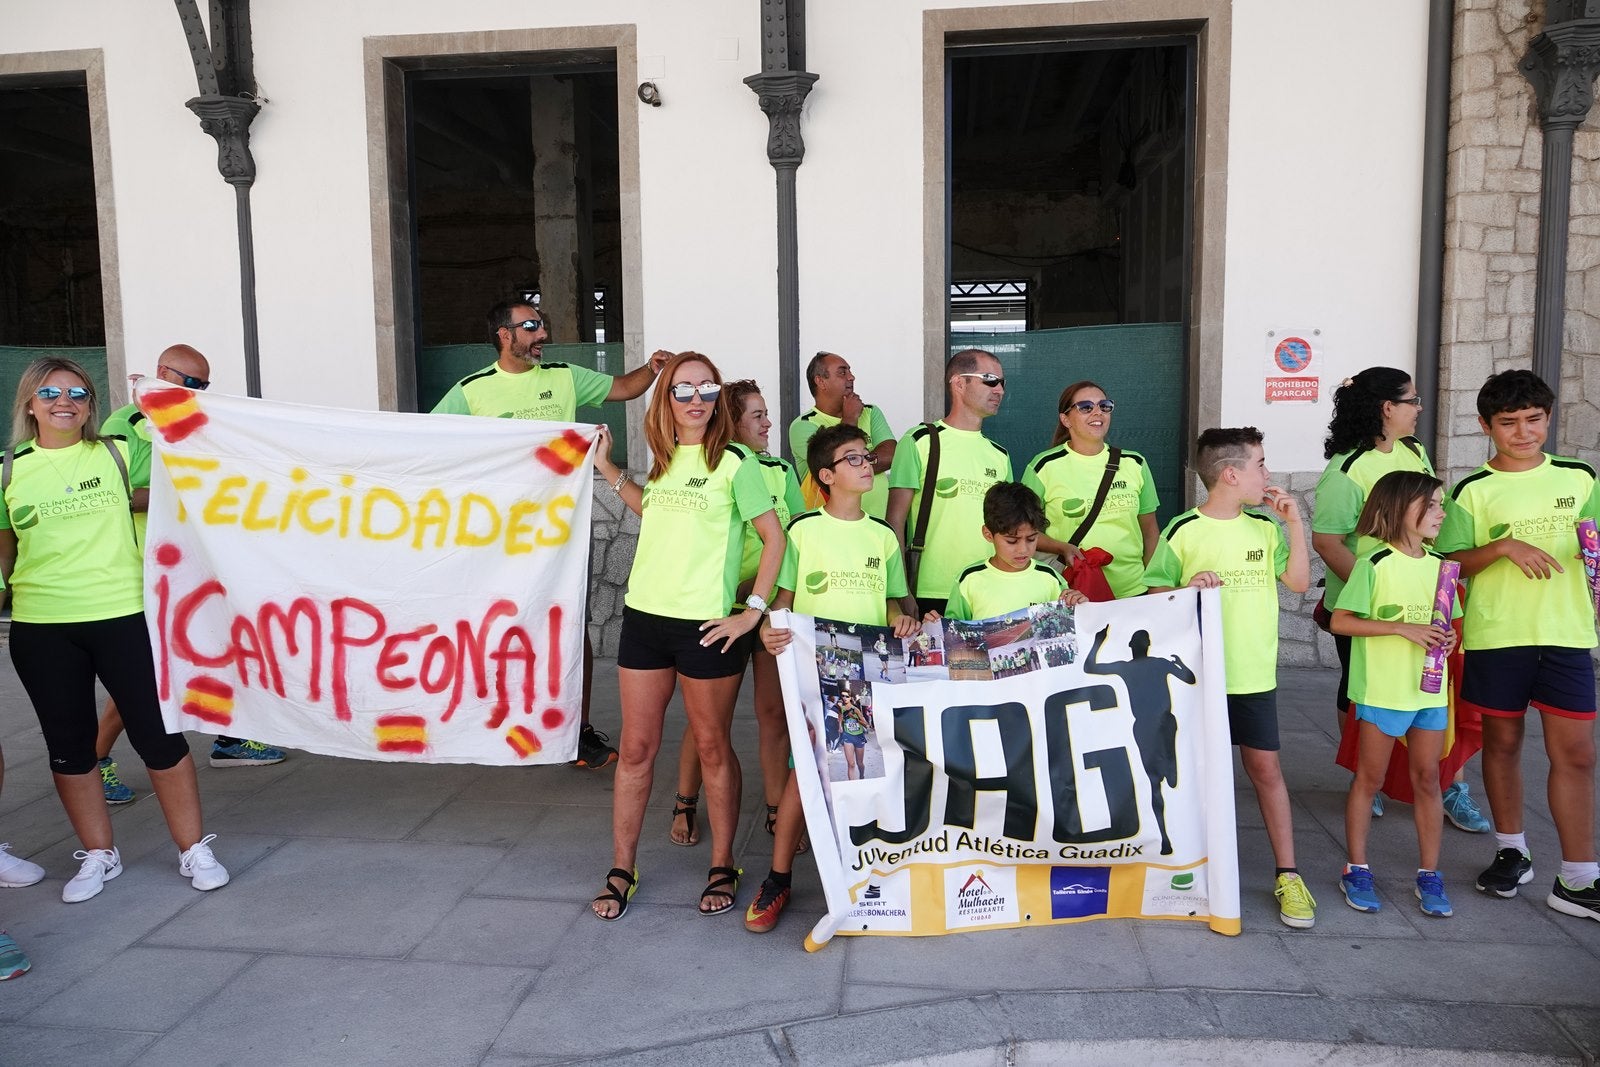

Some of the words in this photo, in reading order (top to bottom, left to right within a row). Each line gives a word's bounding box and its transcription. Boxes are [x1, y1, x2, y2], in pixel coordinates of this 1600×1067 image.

[77, 479, 98, 492] JAG
[685, 477, 704, 487] JAG
[38, 497, 79, 509] CLÍNICA
[81, 489, 118, 500] DENTAL
[650, 494, 709, 511] ROMACHO
[679, 490, 709, 502] DENTAL
[40, 496, 120, 518] ROMACHO
[1554, 497, 1573, 509] JAG
[1515, 522, 1574, 536] ROMACH
[1245, 550, 1262, 561] JAG
[849, 684, 1140, 847] JAG
[852, 830, 949, 871] Juventud
[956, 832, 1049, 859] Atlética
[1059, 843, 1143, 859] Guadix
[958, 885, 984, 898] Hotel
[958, 895, 1005, 909] Mulhacén
[959, 906, 1005, 916] RESTAURANTE
